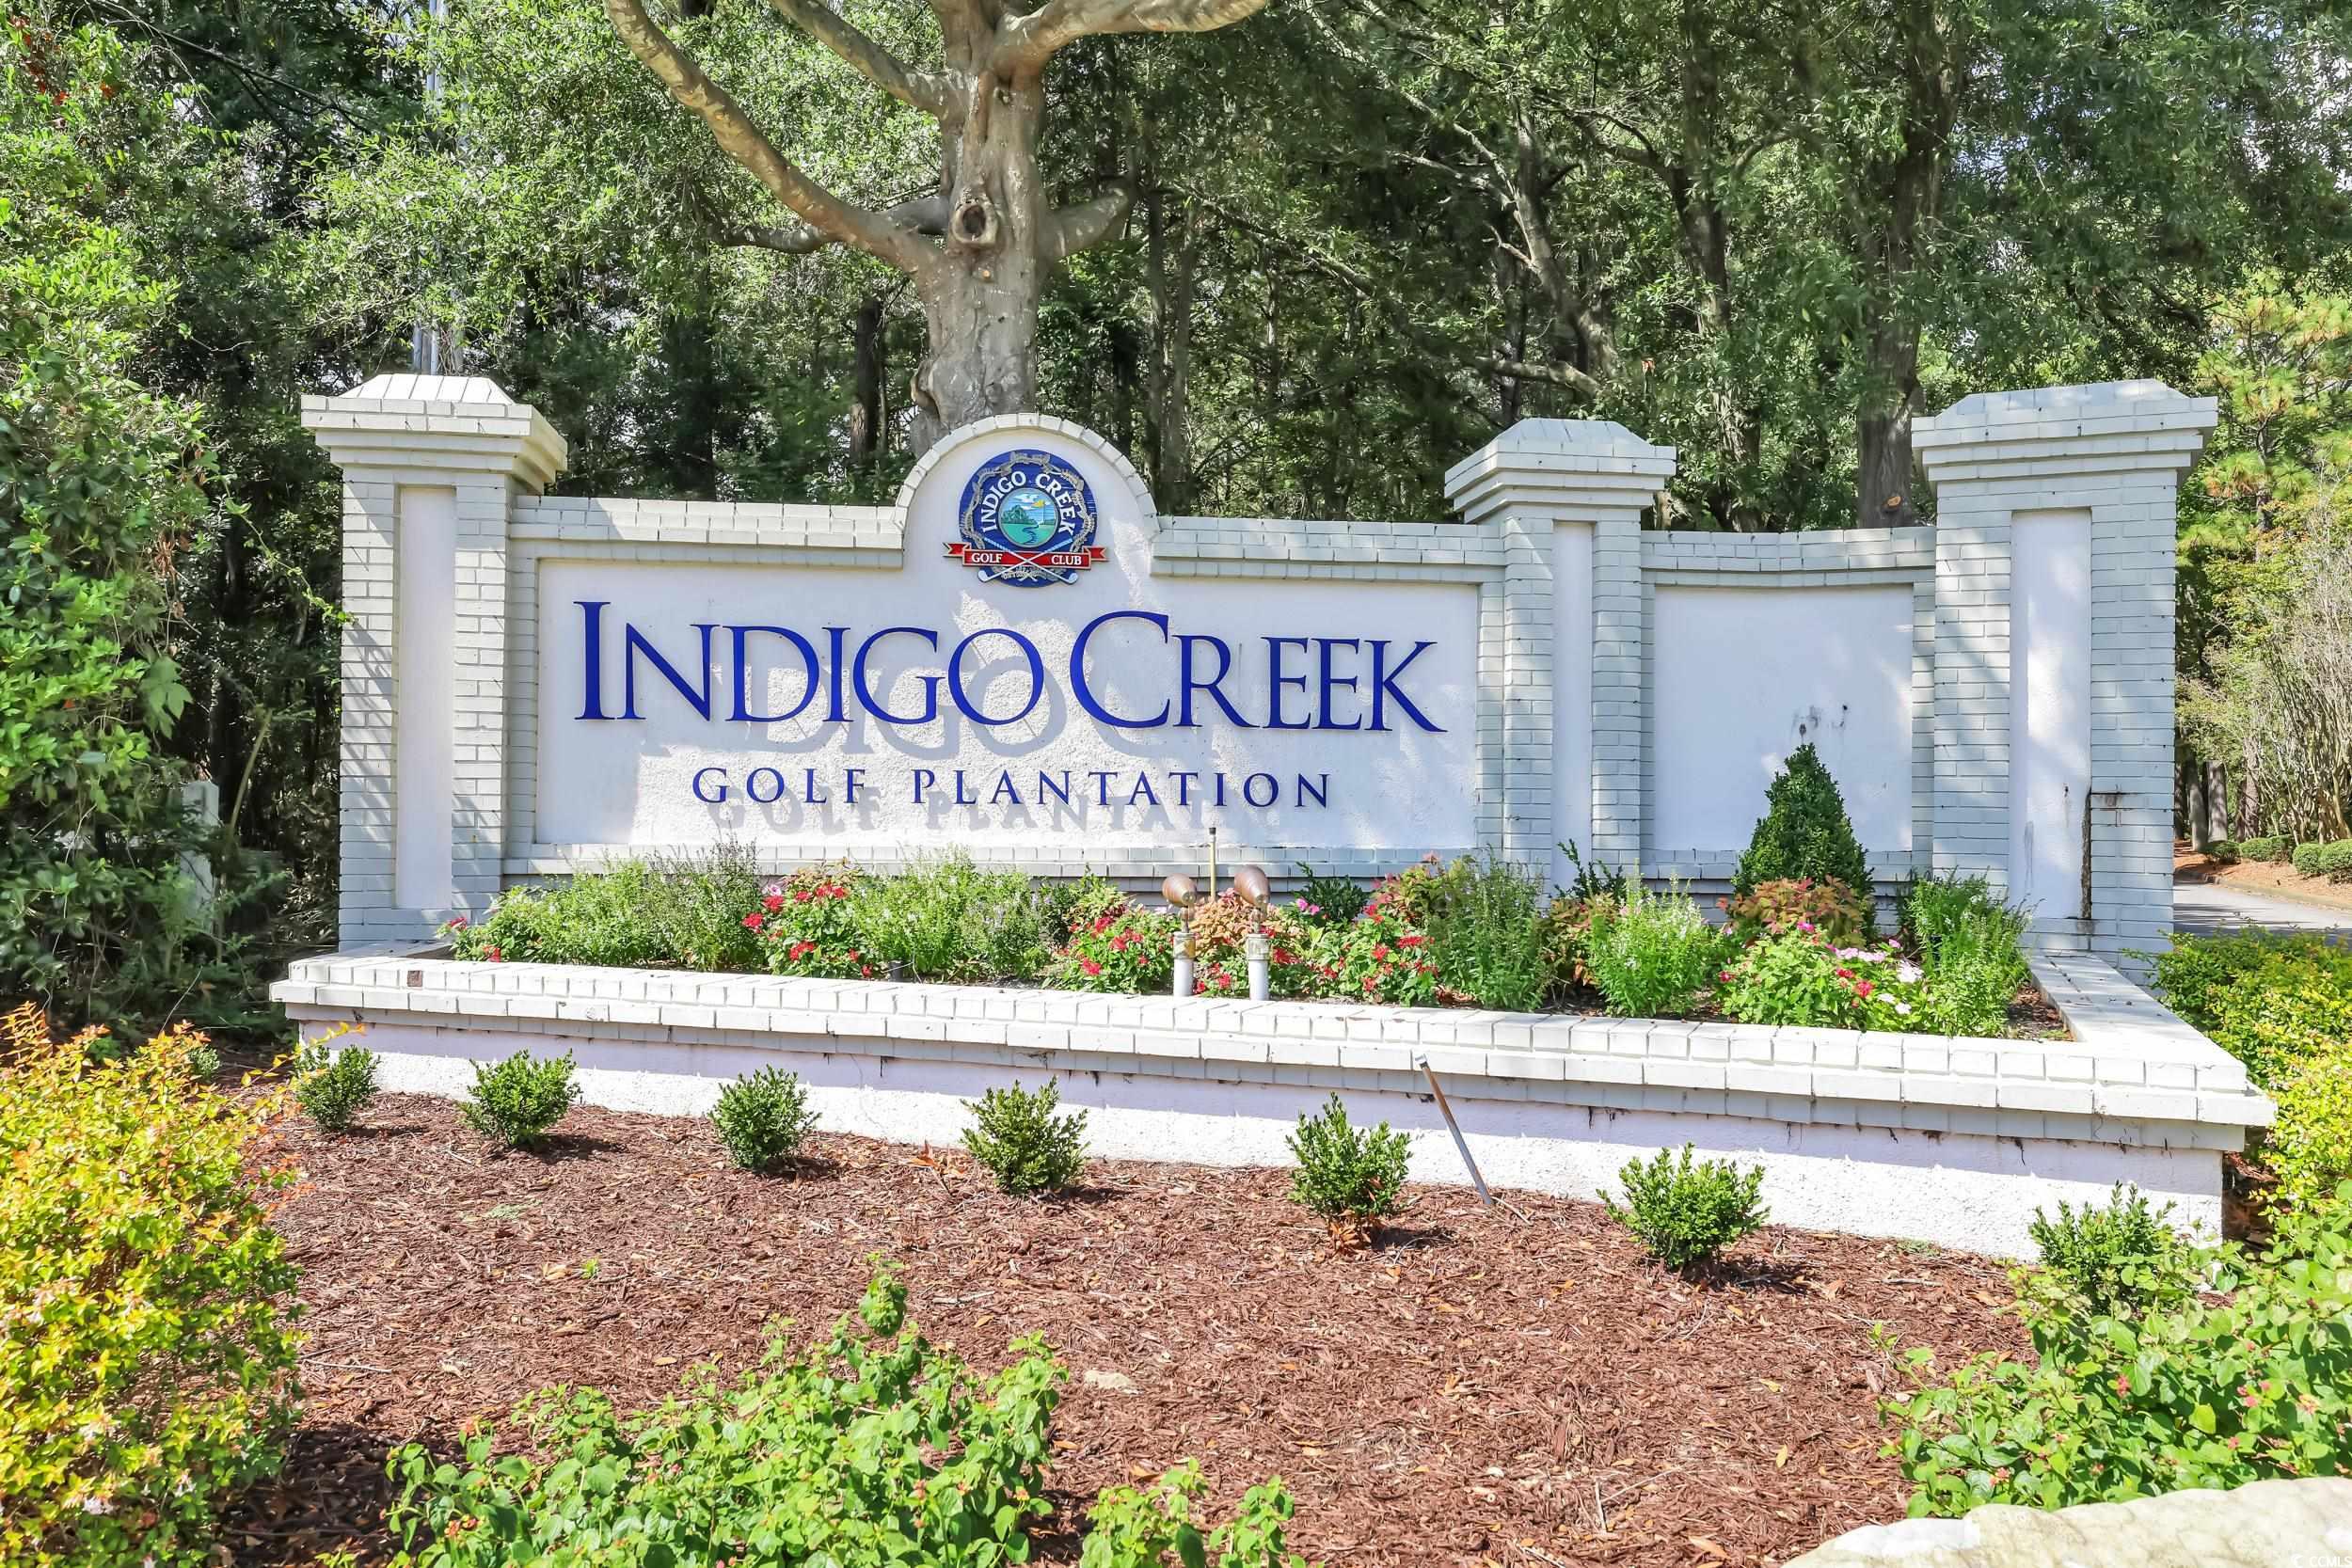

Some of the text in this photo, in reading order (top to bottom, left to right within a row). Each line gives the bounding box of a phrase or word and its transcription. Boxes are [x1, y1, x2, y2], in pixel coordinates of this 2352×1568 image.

[981, 470, 1076, 536] INDIGO CREEK
[971, 553, 1082, 565] GOLF CLUB
[573, 601, 1449, 733] INDIGO CREEK
[692, 767, 1331, 809] GOLF PLANTATION
